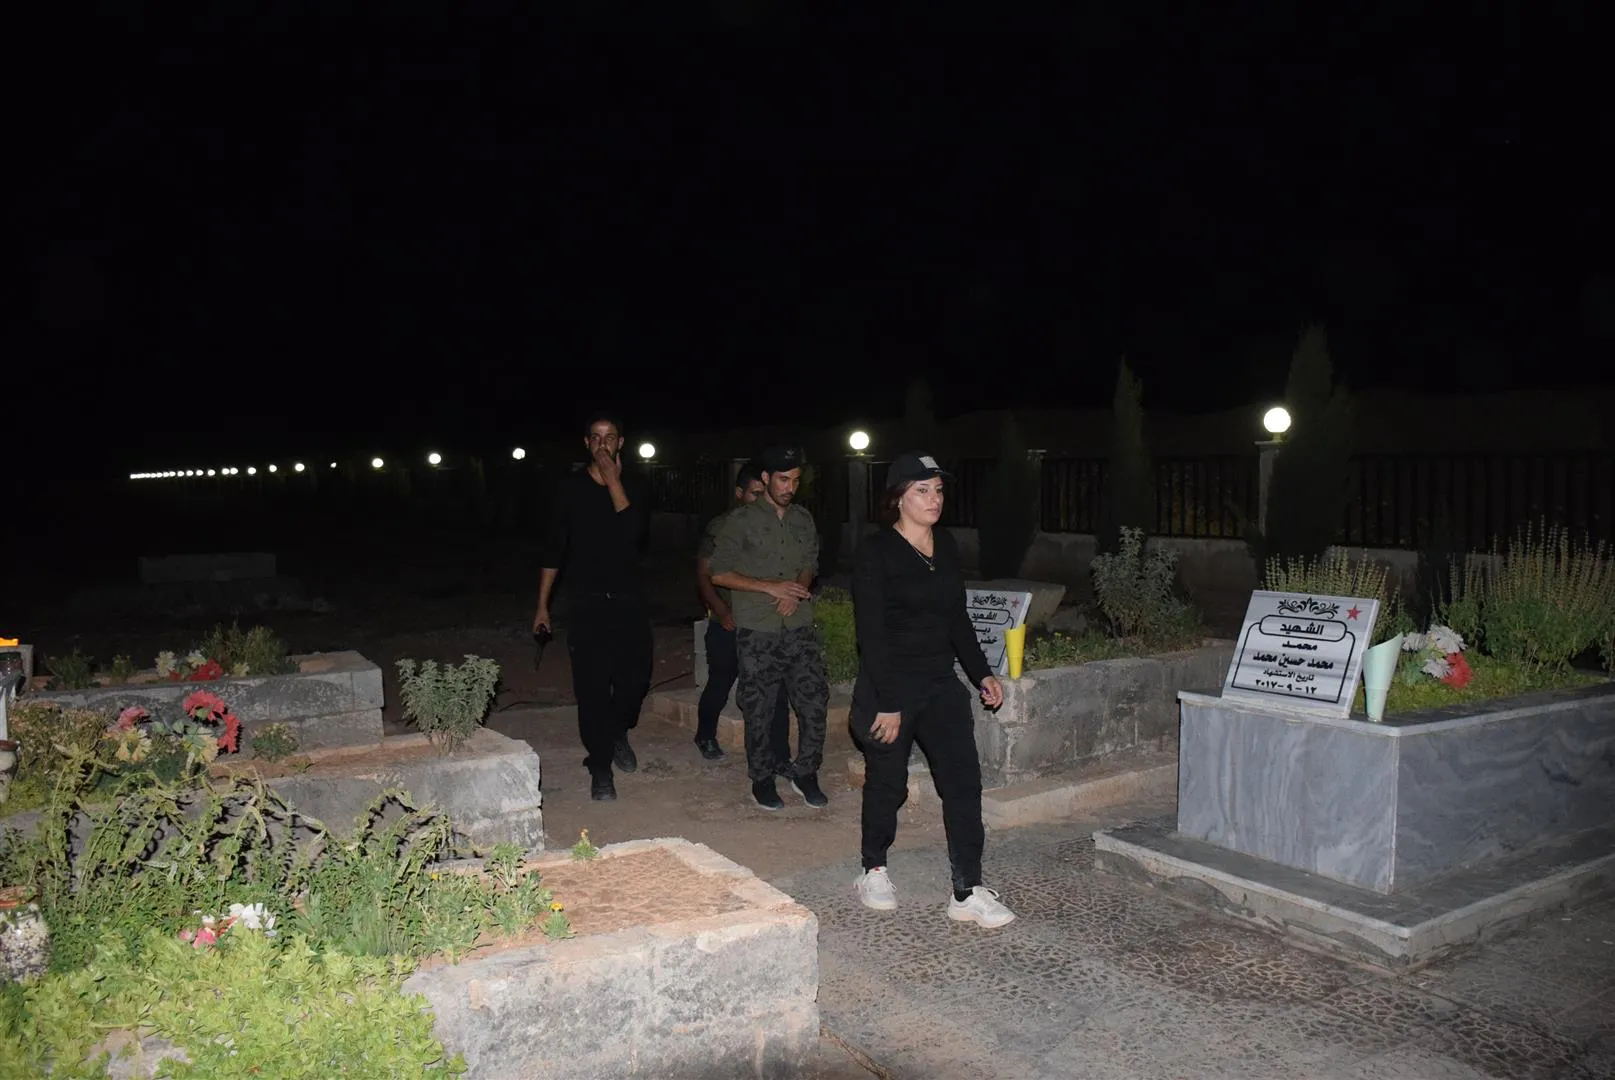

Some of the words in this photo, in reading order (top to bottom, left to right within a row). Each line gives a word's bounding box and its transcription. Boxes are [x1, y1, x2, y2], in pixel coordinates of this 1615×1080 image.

[971, 611, 997, 621] الشهيد
[1280, 622, 1325, 635] الشهيد
[1282, 640, 1318, 651] محمد
[1253, 651, 1278, 663] محمد
[1278, 653, 1305, 668] حسين
[1307, 658, 1334, 670] محمد
[1263, 669, 1296, 679] الاستشهاد
[1295, 673, 1315, 682] تاريخ
